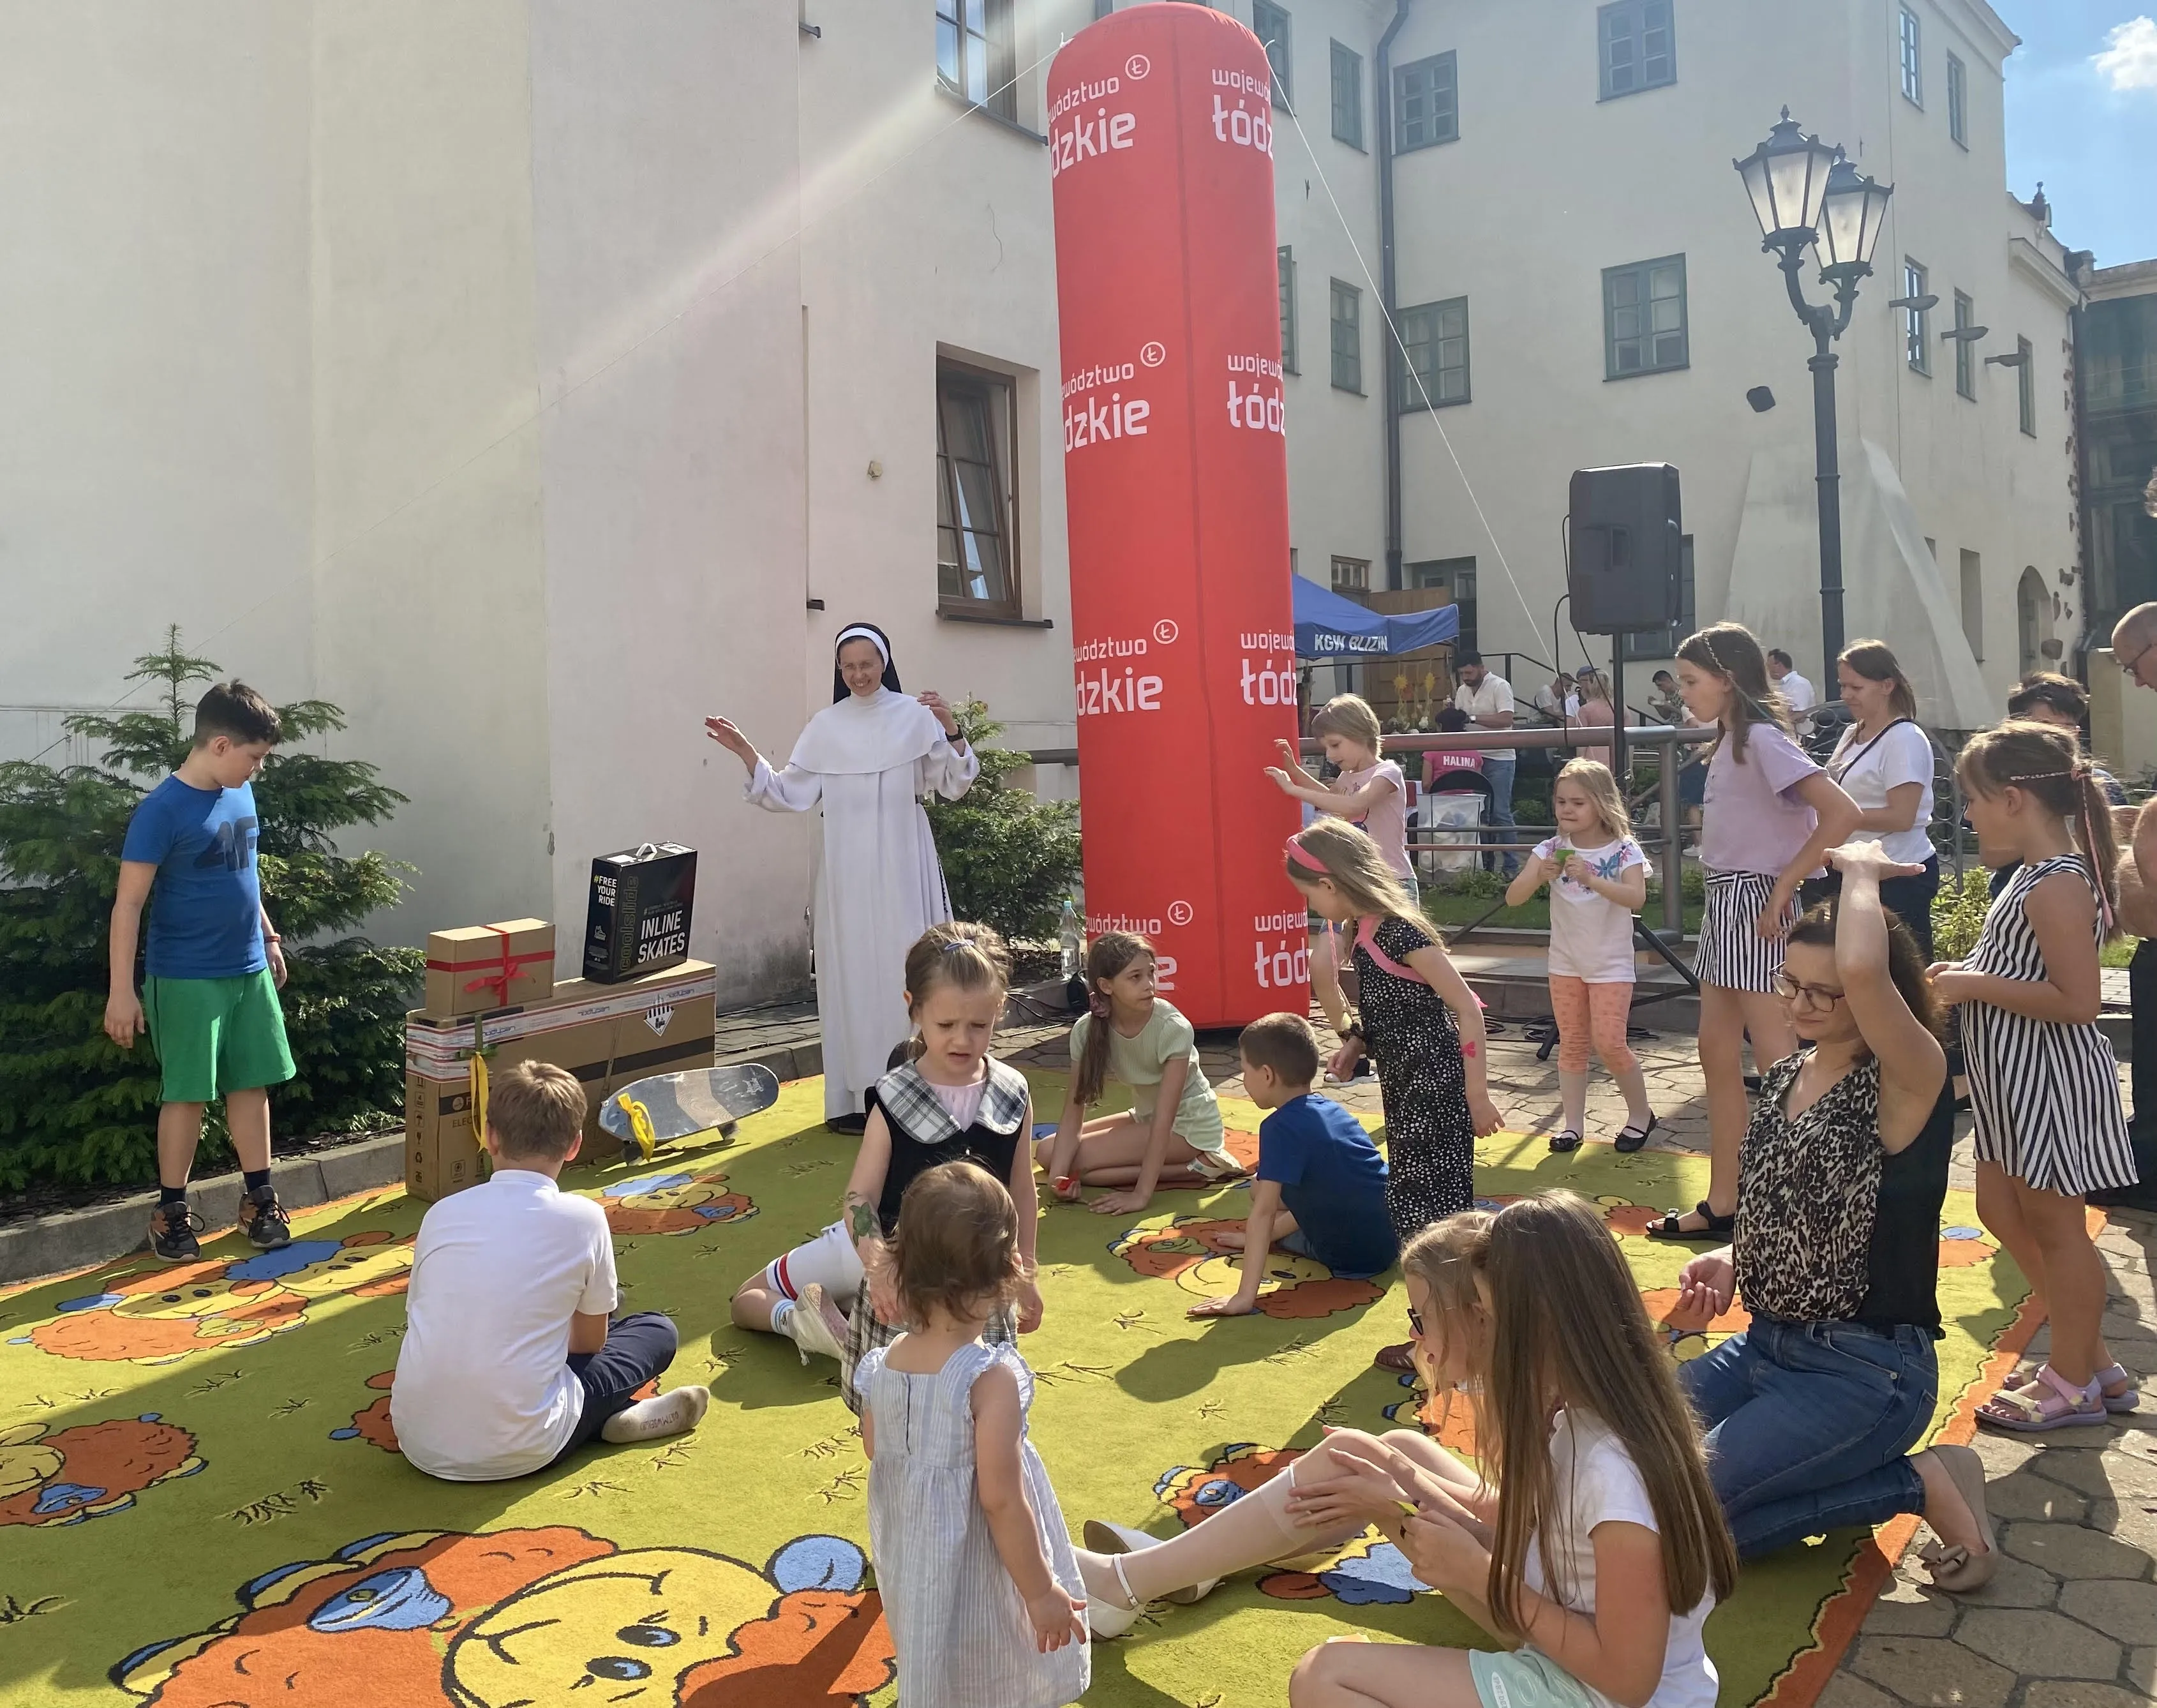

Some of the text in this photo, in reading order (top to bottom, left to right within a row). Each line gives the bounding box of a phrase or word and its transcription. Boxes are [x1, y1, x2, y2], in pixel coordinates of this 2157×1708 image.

[1048, 76, 1119, 127] wództwo
[1315, 634, 1346, 651] KGW
[1443, 755, 1475, 768] HALINA
[593, 875, 617, 888] #FREE
[597, 885, 616, 897] YOUR
[598, 895, 615, 907] RIDE
[620, 875, 638, 971] coolslide
[641, 910, 683, 940] INLINE
[638, 932, 685, 964] SKATES
